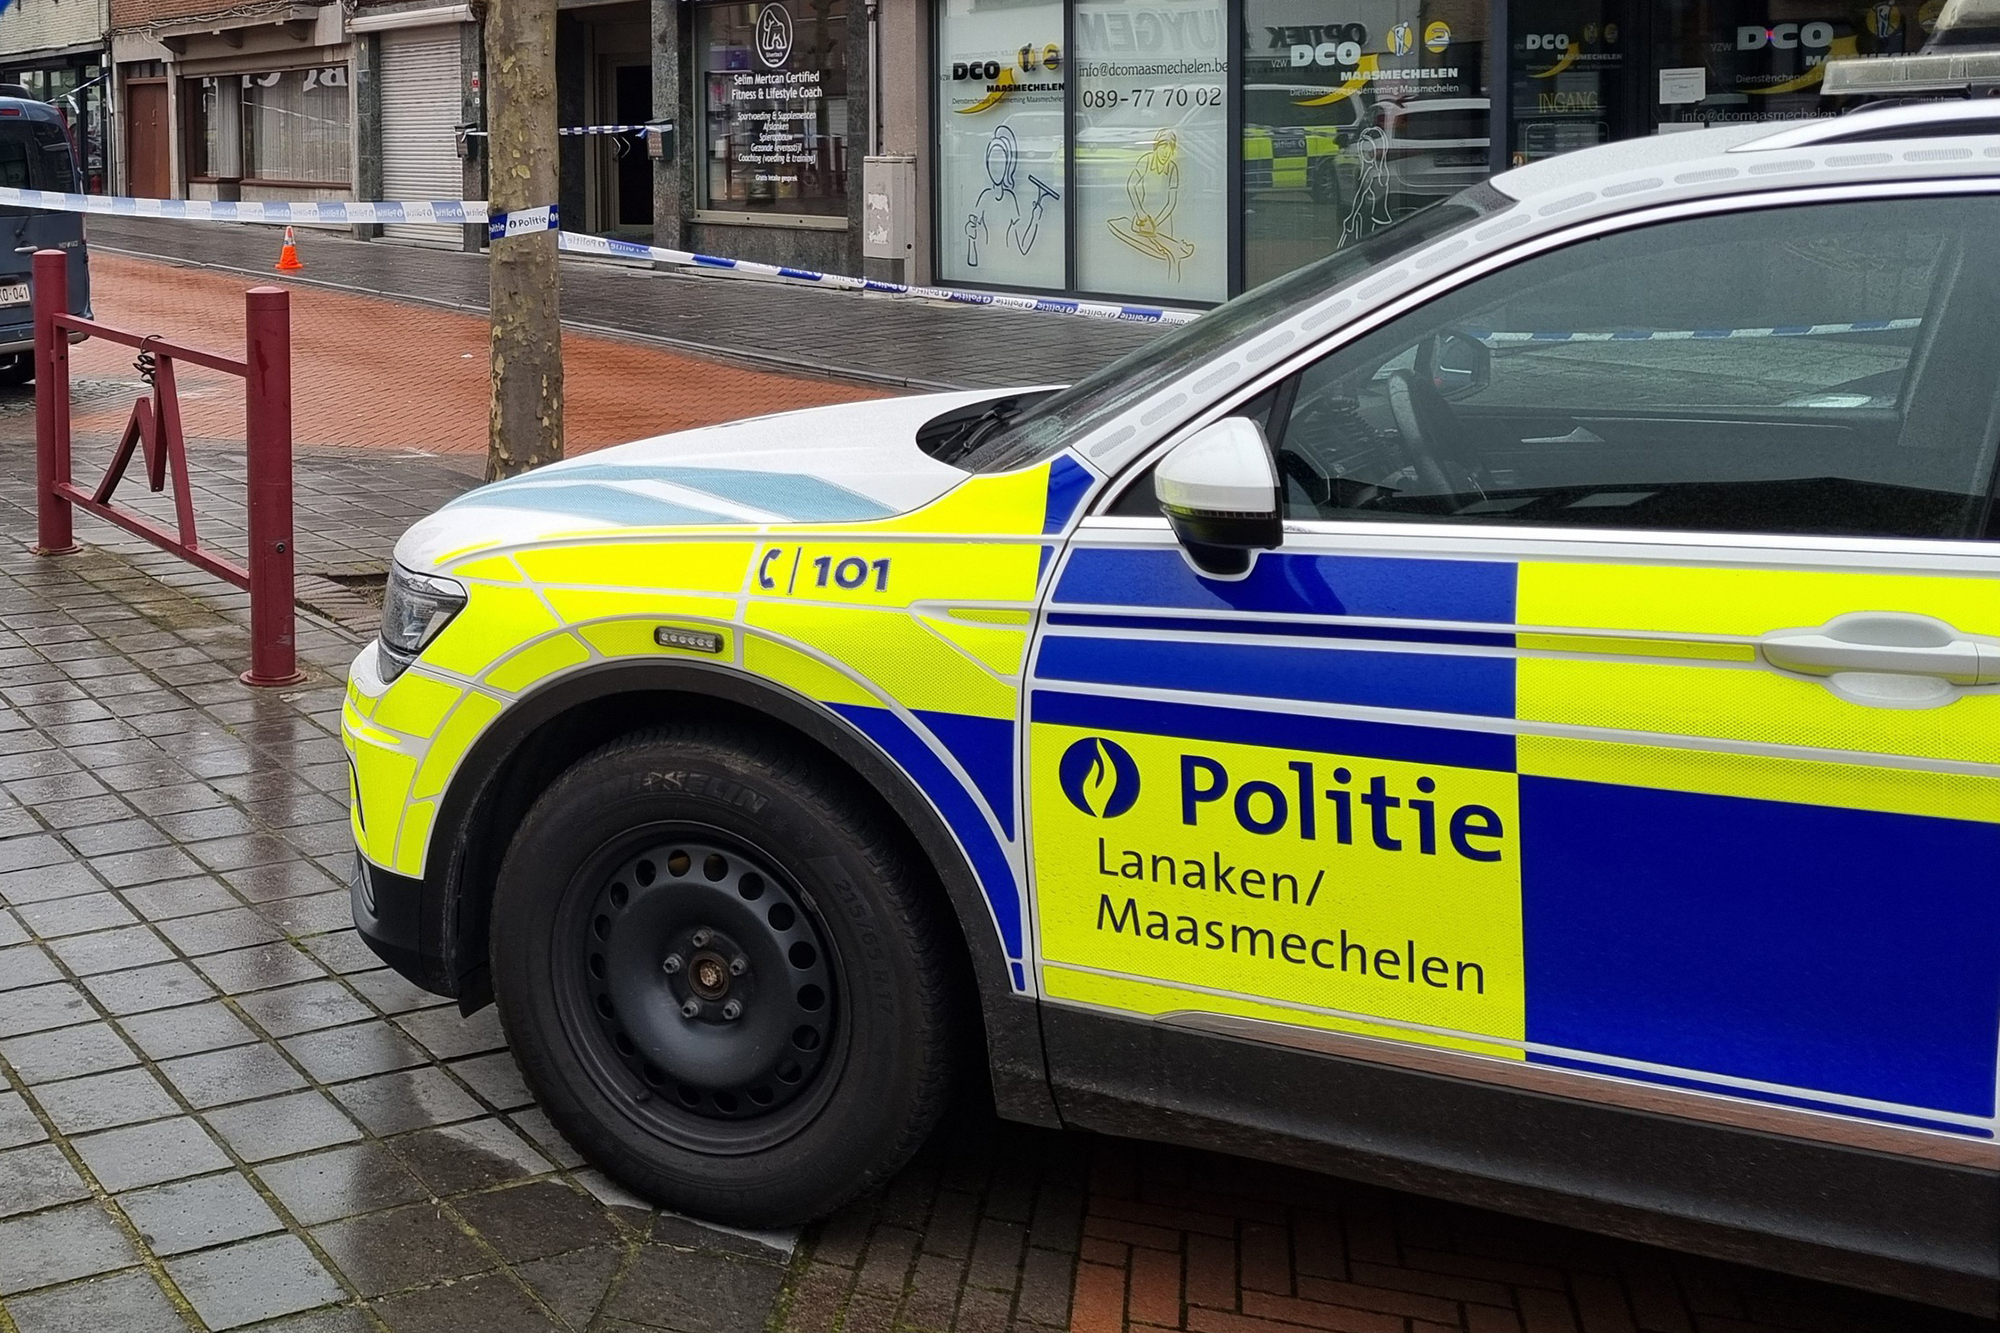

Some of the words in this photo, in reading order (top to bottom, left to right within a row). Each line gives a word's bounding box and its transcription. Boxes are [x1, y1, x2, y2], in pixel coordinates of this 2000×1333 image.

[1526, 34, 1569, 50] DCO
[1711, 43, 1732, 52] VZW
[1737, 22, 1834, 50] DCO
[1271, 59, 1288, 68] VZW
[1291, 41, 1361, 67] DCO
[953, 61, 1000, 80] DCO
[1079, 58, 1228, 77] info@dcomaasmechelen.be
[1341, 68, 1458, 81] MAASMECHELEN
[734, 74, 753, 85] Selim
[755, 73, 784, 84] Mertcan
[786, 71, 819, 83] Certified
[987, 83, 1064, 92] MAASMECHELEN
[732, 89, 756, 100] Fitness
[758, 88, 764, 98] &
[766, 87, 798, 100] Lifestyle
[799, 86, 822, 98] Coach
[1083, 89, 1155, 107] 089-77
[1163, 88, 1188, 107] 70
[1196, 87, 1221, 106] 02
[1400, 84, 1459, 93] Maasmechelen
[1539, 91, 1599, 113] INGANG
[777, 111, 817, 123] Supplementen
[518, 215, 547, 227] Politie
[954, 292, 981, 302] Politie
[995, 298, 1024, 308] Politie
[1037, 302, 1066, 313] Politie
[1079, 307, 1107, 317] Politie
[1120, 312, 1150, 321] Politie
[814, 557, 891, 591] 101
[1180, 754, 1504, 862] Politie
[1098, 837, 1325, 907] Lanaken/
[1096, 894, 1485, 994] Maasmechelen
